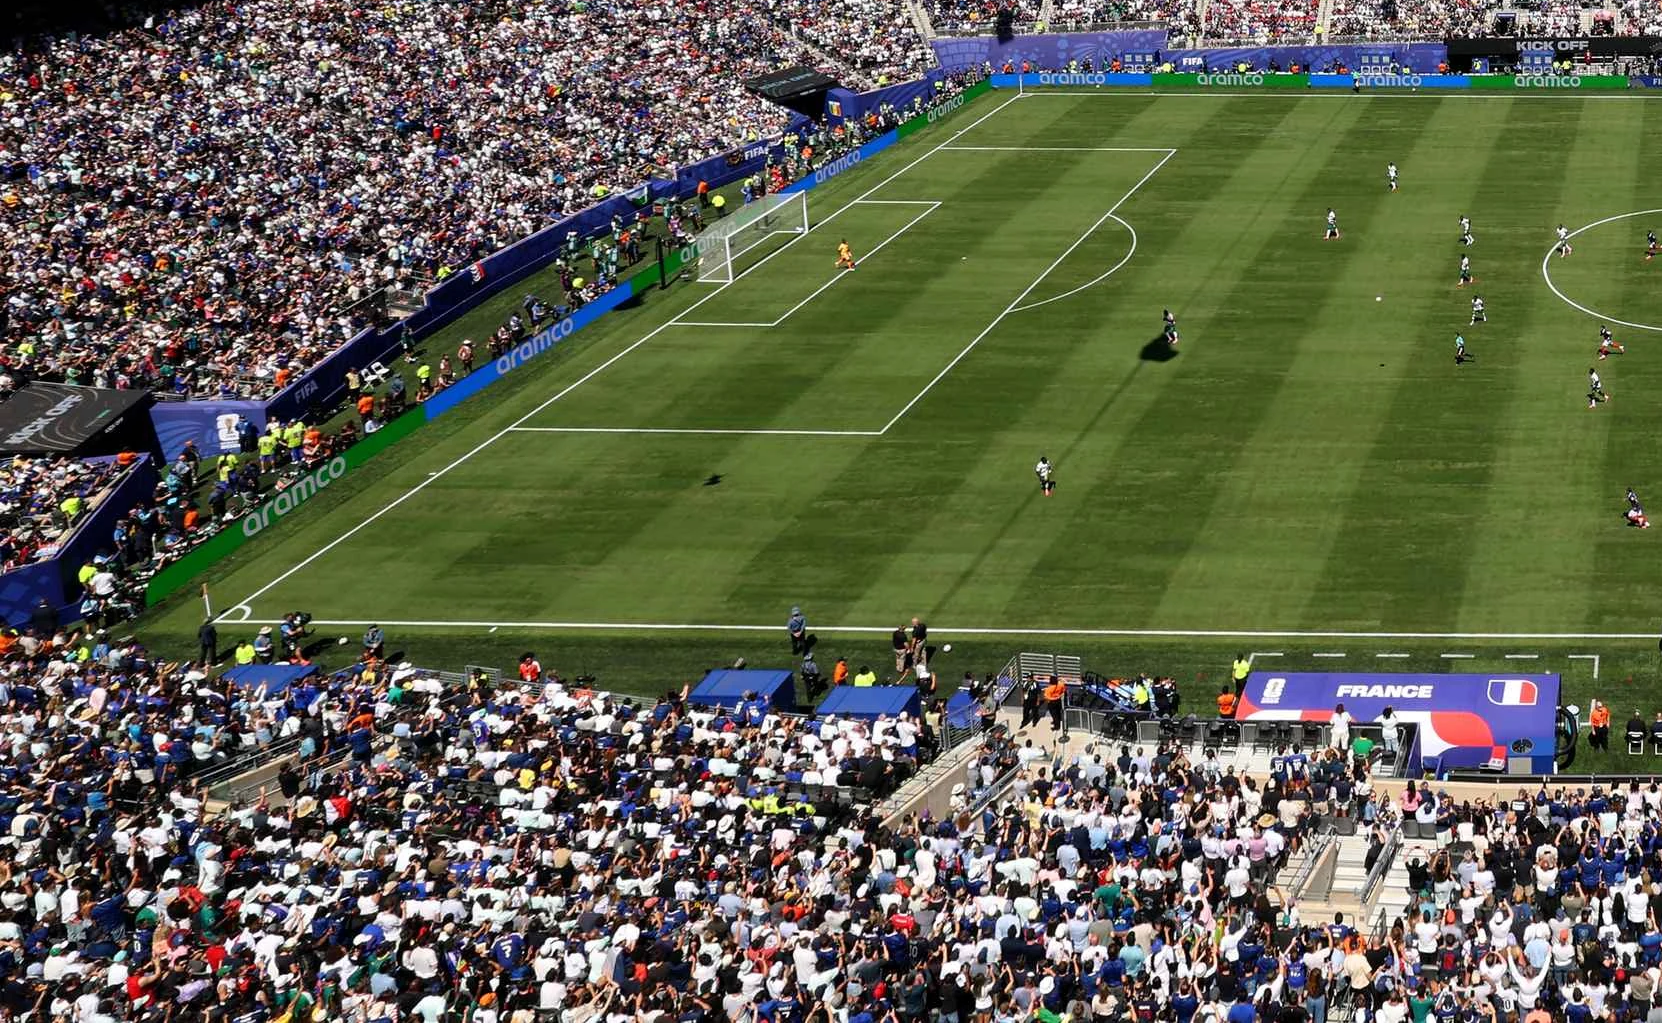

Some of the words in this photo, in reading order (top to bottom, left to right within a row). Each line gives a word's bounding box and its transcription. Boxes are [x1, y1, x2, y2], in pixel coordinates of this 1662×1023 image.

[1516, 40, 1555, 50] KICK
[1557, 40, 1589, 50] OFF
[1182, 57, 1204, 66] FIFA
[1039, 72, 1106, 85] aramco
[1197, 72, 1264, 86] aramco
[1358, 73, 1422, 87] aramco
[1514, 74, 1581, 88] aramco
[927, 95, 965, 125] aramco
[744, 146, 766, 160] FIFA
[815, 150, 862, 185] aramco
[495, 317, 574, 375] aramco
[294, 379, 319, 404] FIFA
[242, 456, 346, 537] aramco
[1336, 684, 1434, 699] FRANCE
[1274, 763, 1284, 772] 10
